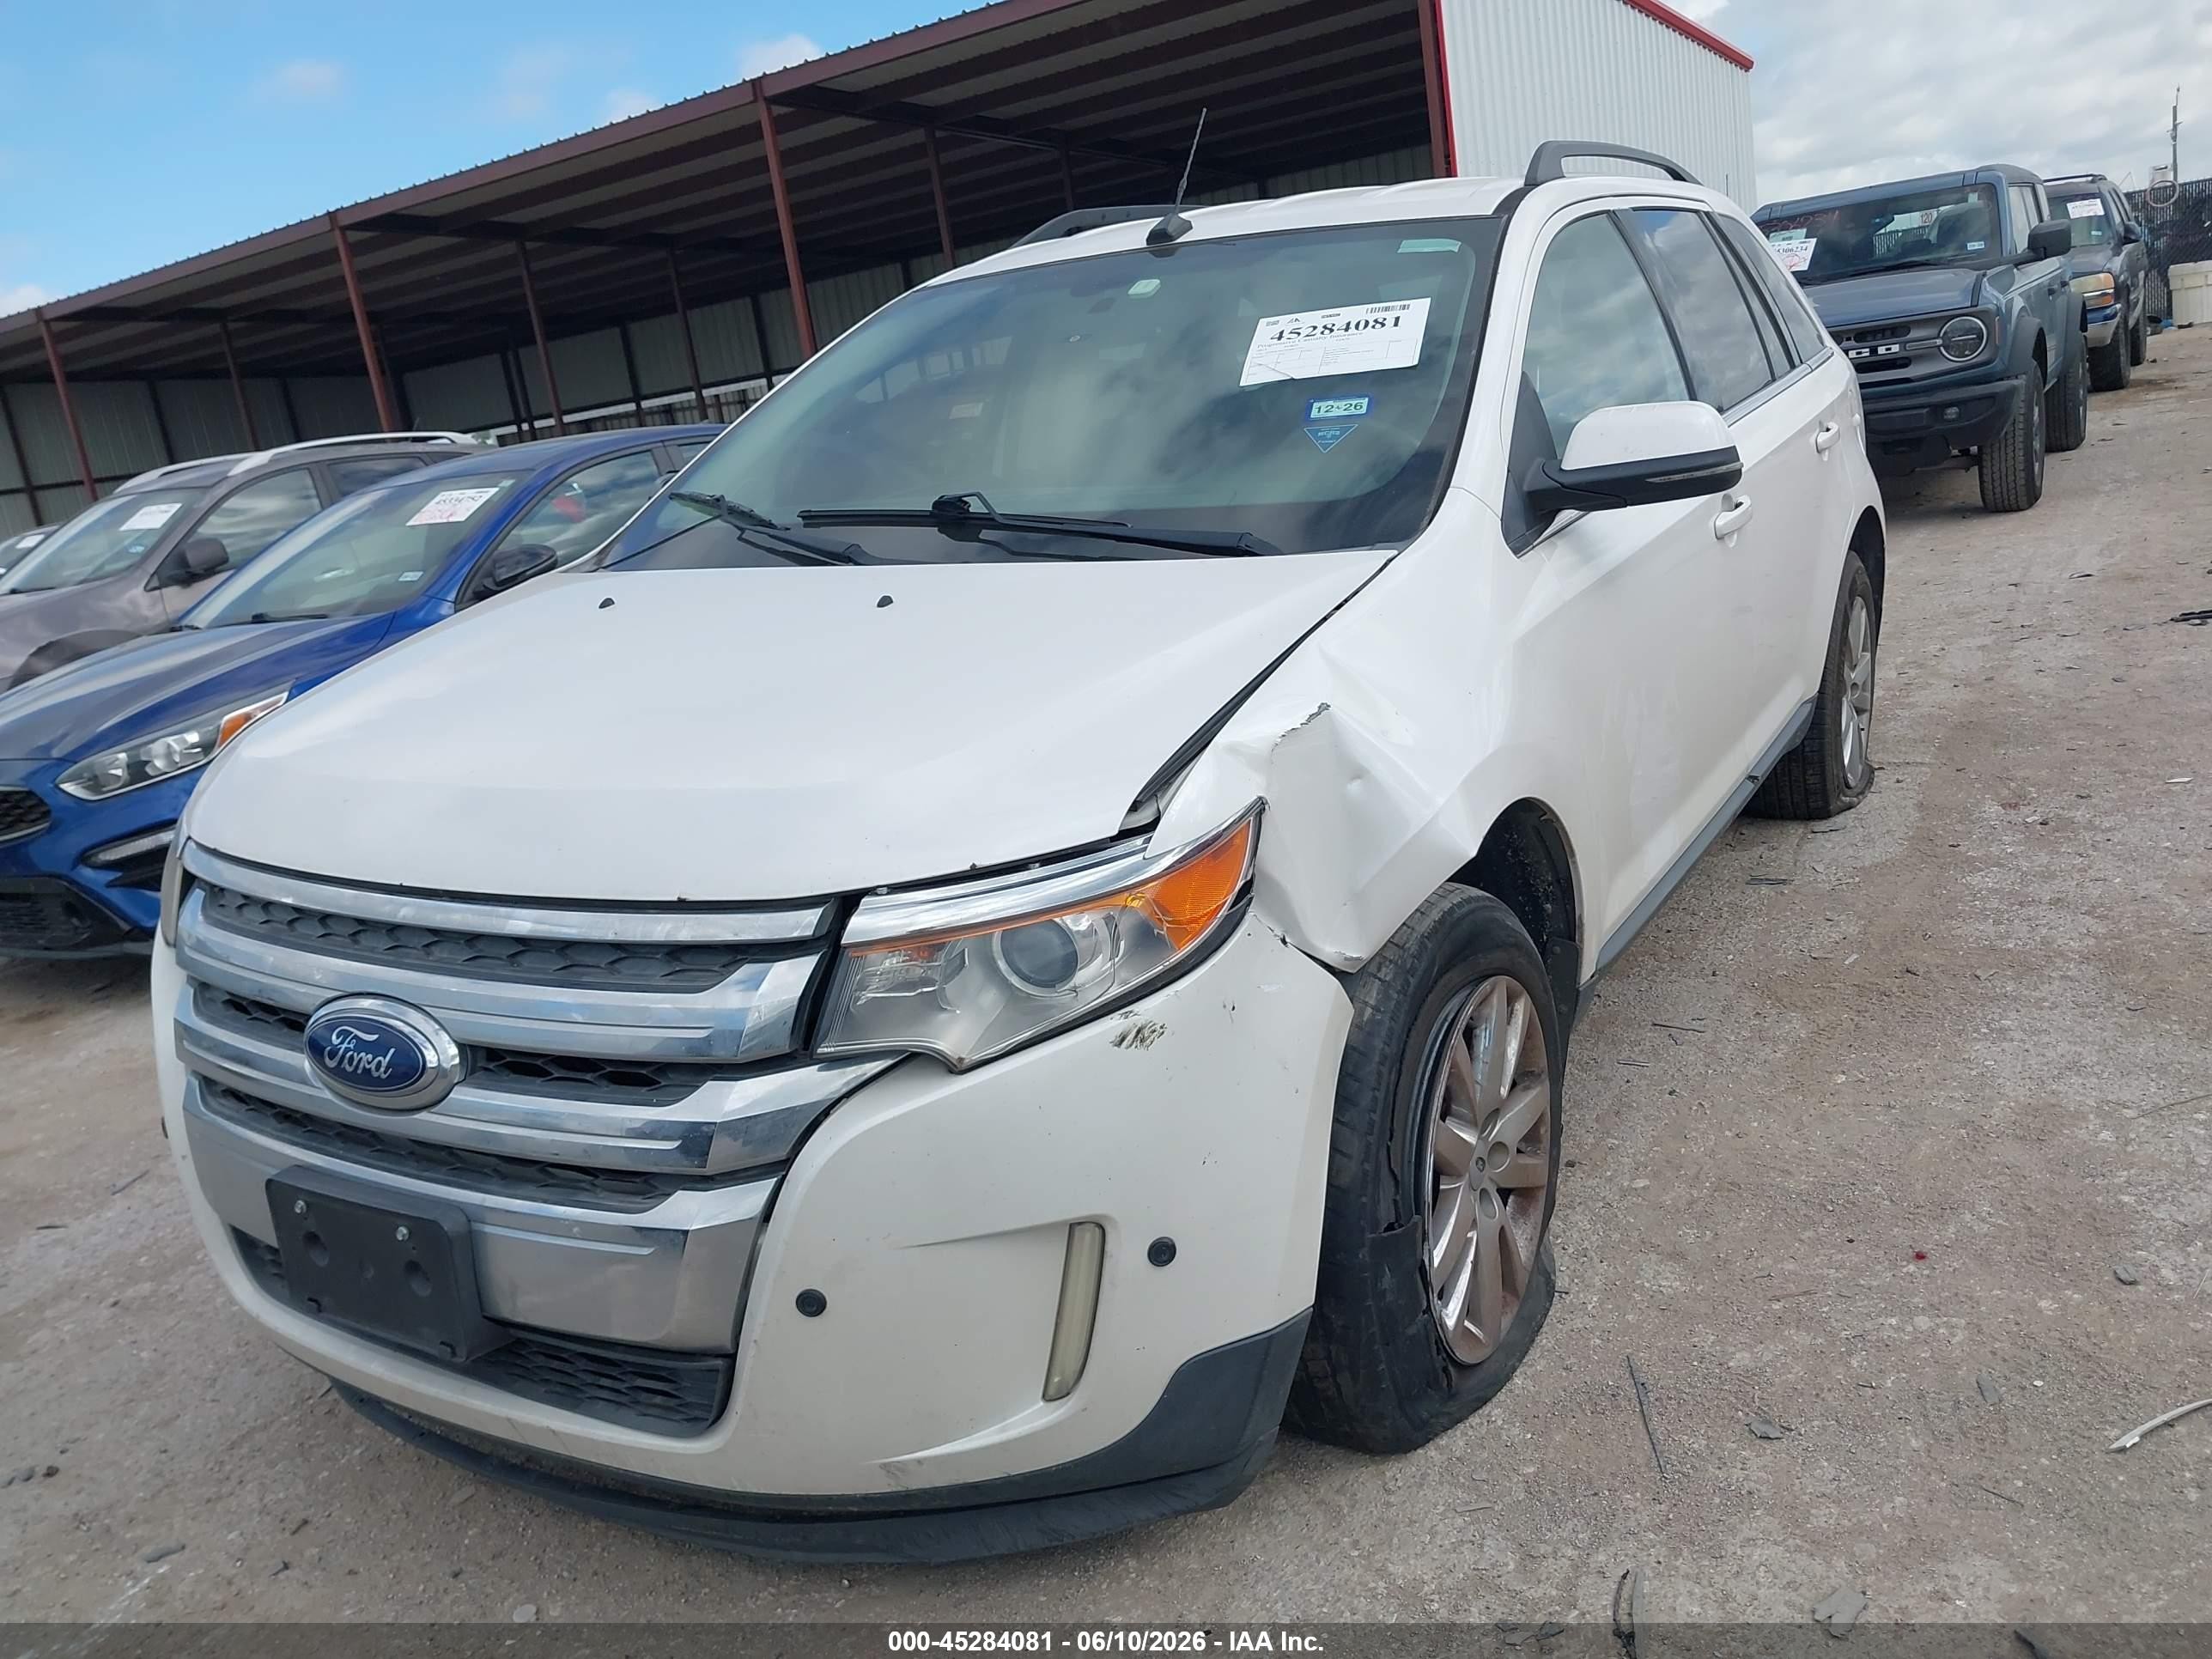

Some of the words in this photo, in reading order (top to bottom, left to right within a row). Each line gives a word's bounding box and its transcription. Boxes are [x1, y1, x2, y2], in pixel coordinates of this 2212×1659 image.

[1920, 212, 1932, 224] 120
[1270, 315, 1401, 342] 45284081
[323, 1025, 396, 1079] Ford
